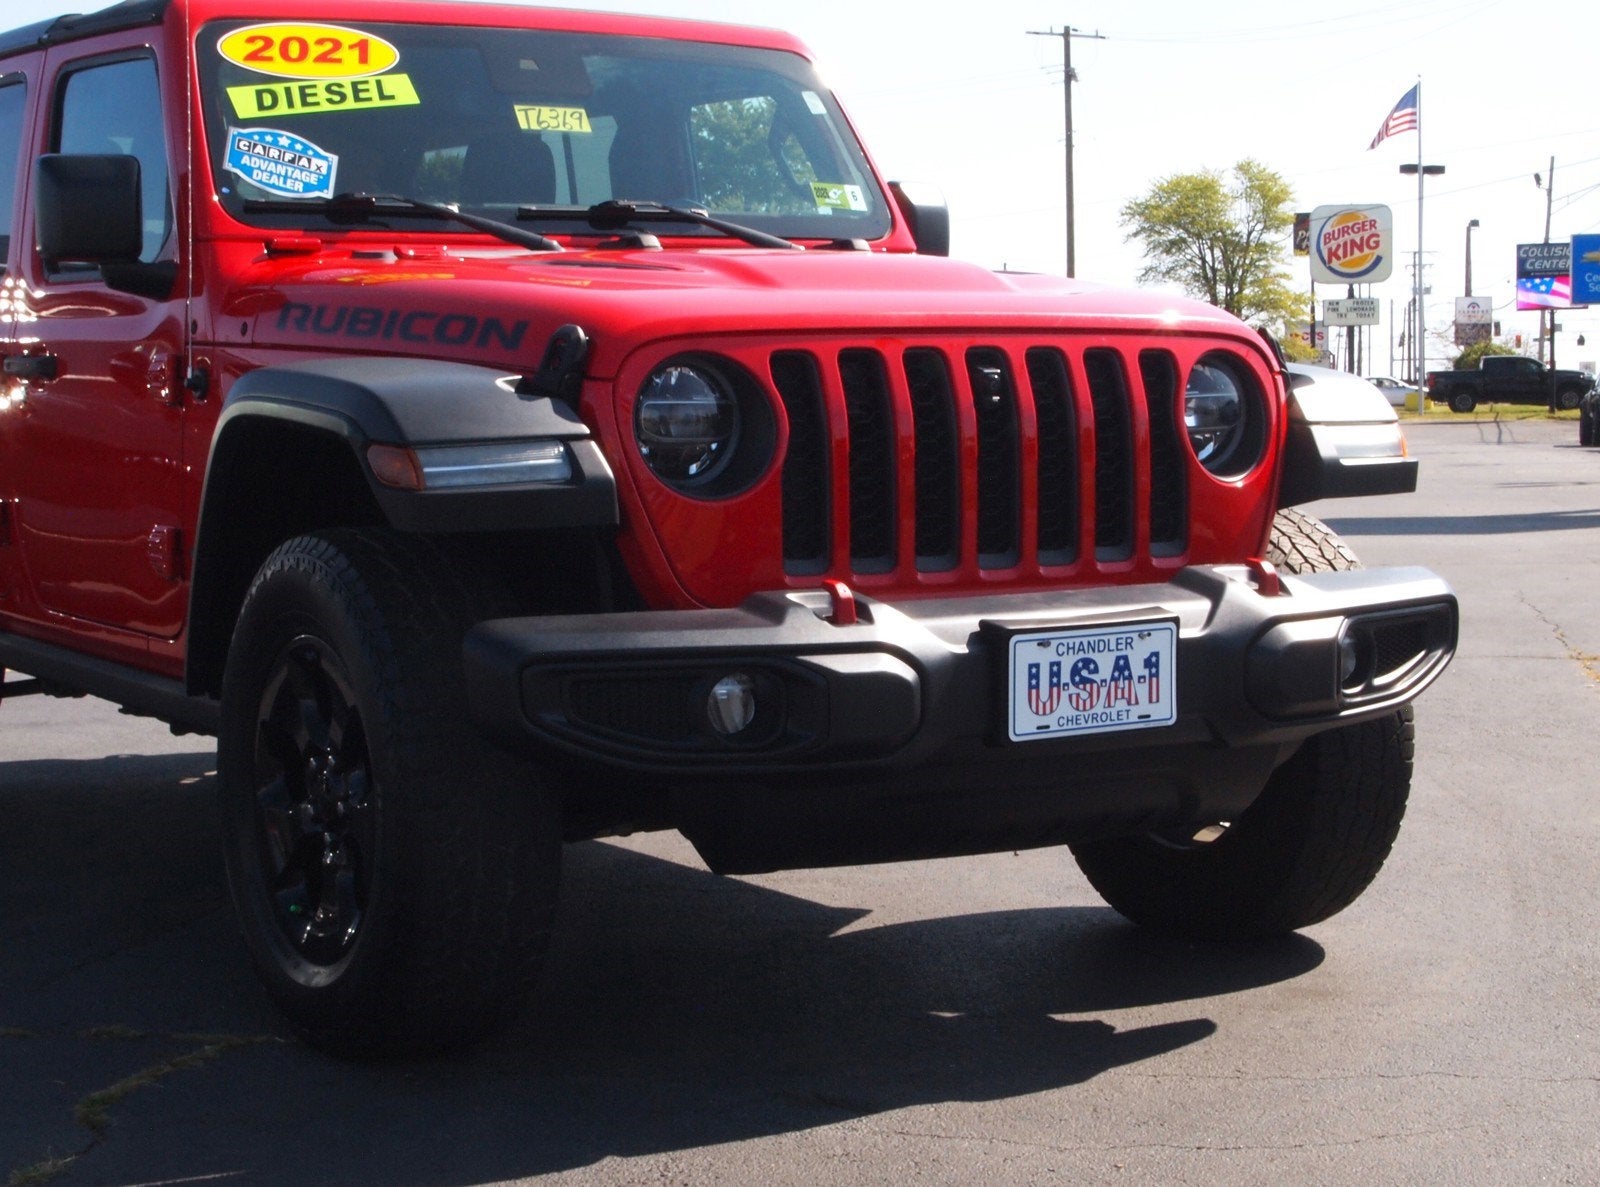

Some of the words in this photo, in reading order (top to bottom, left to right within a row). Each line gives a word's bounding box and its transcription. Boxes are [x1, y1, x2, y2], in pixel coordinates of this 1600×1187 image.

[243, 35, 369, 65] 2021
[254, 79, 396, 112] DIESEL
[518, 107, 584, 131] T6369
[238, 140, 325, 173] CARFAX
[241, 155, 319, 185] ADVANTAGE
[252, 169, 304, 192] DEALER
[1323, 219, 1378, 246] BURGER
[1326, 233, 1381, 265] KING
[276, 302, 530, 350] RUBICON
[1055, 636, 1134, 657] CHANDLER
[1057, 709, 1132, 728] CHEVROLET
